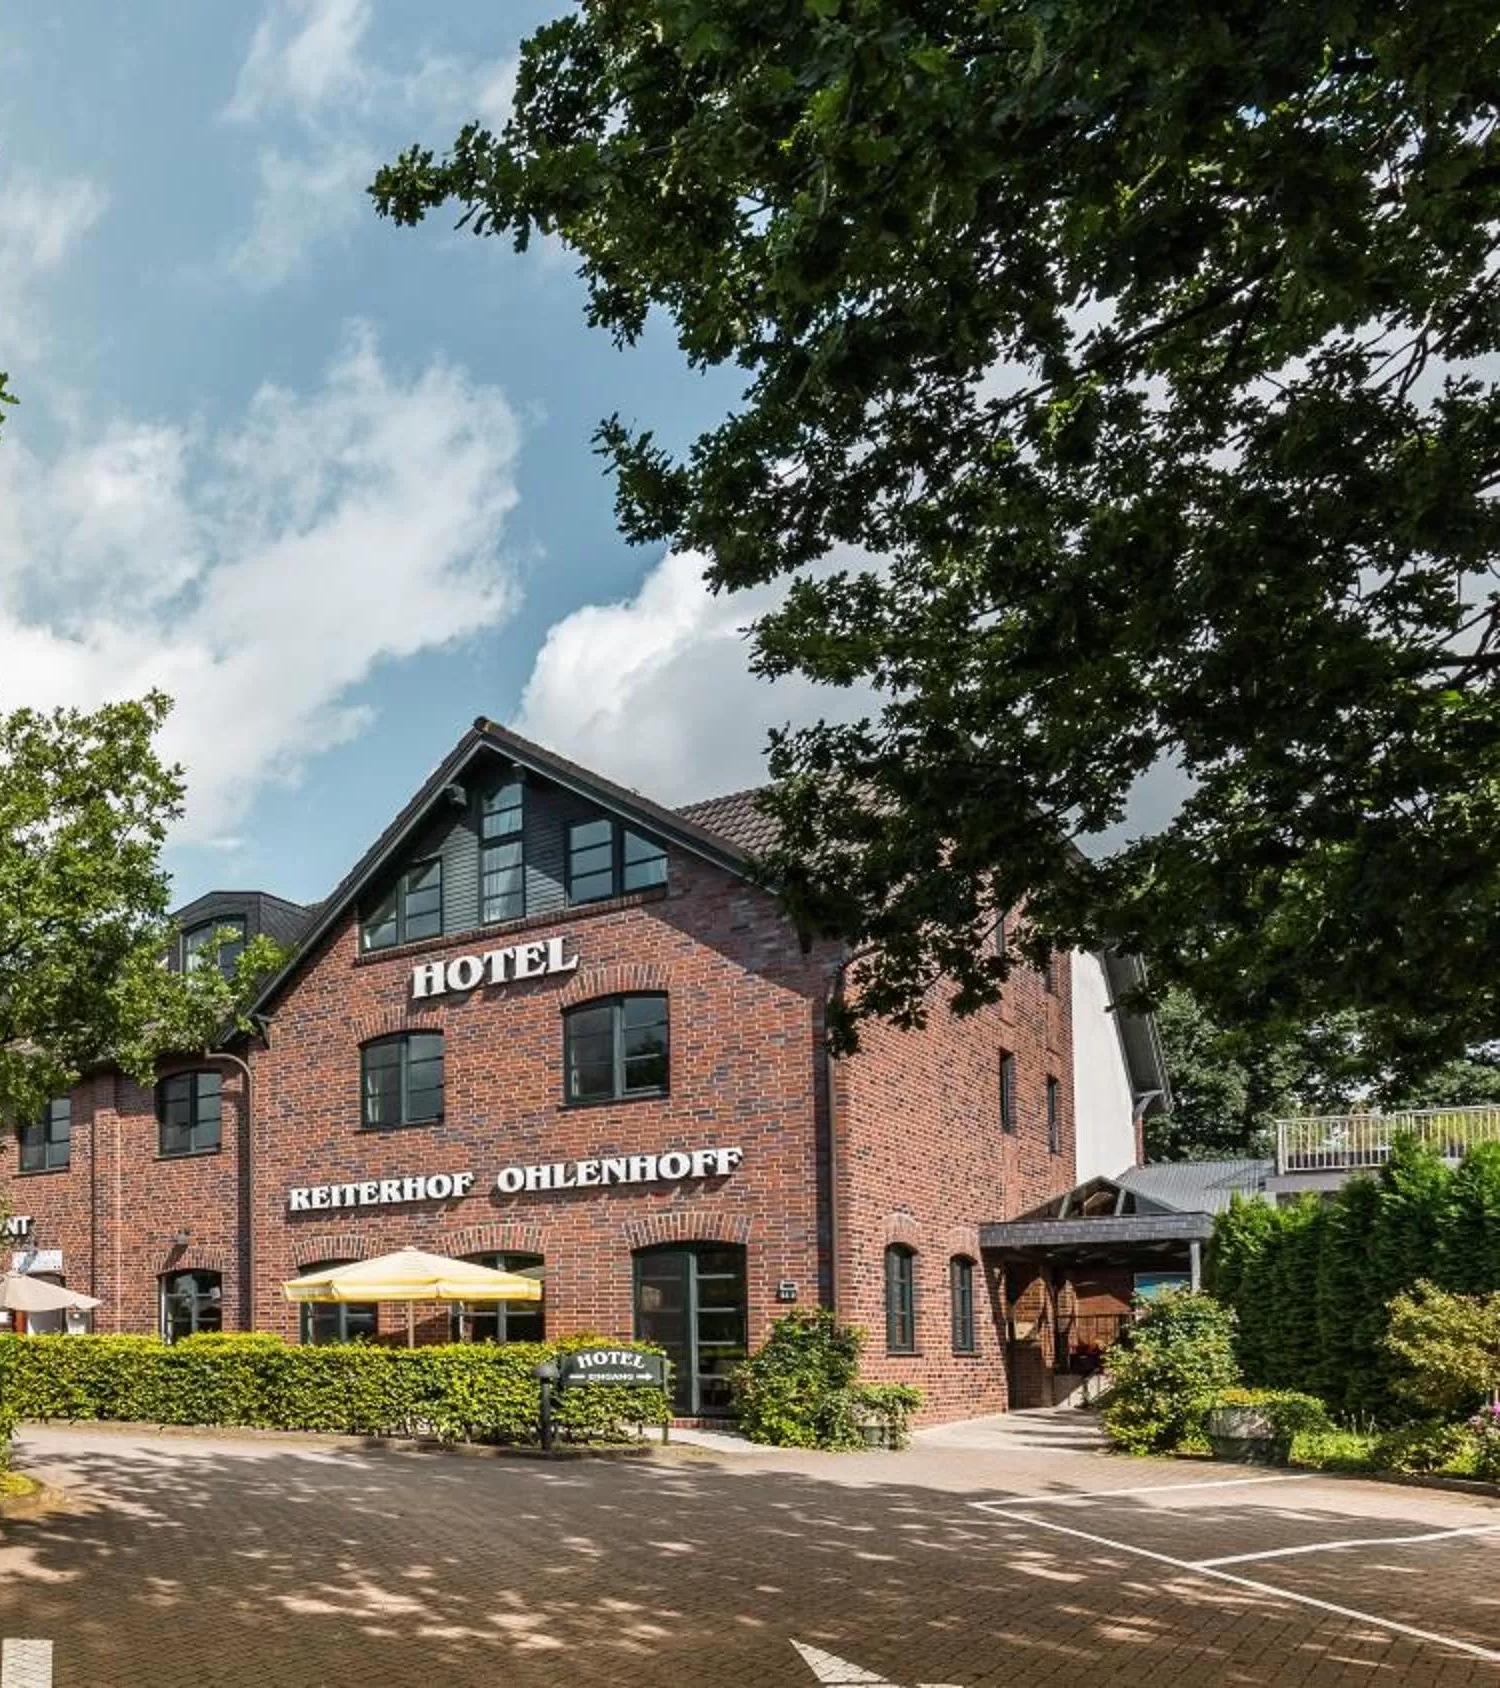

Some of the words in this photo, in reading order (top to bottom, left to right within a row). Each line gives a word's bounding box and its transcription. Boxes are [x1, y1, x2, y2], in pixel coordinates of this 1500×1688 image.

[412, 937, 580, 998] HOTEL
[289, 1172, 474, 1211] REITERHOF
[497, 1147, 743, 1193] OHLENHOFF
[577, 1351, 645, 1369] HOTEL
